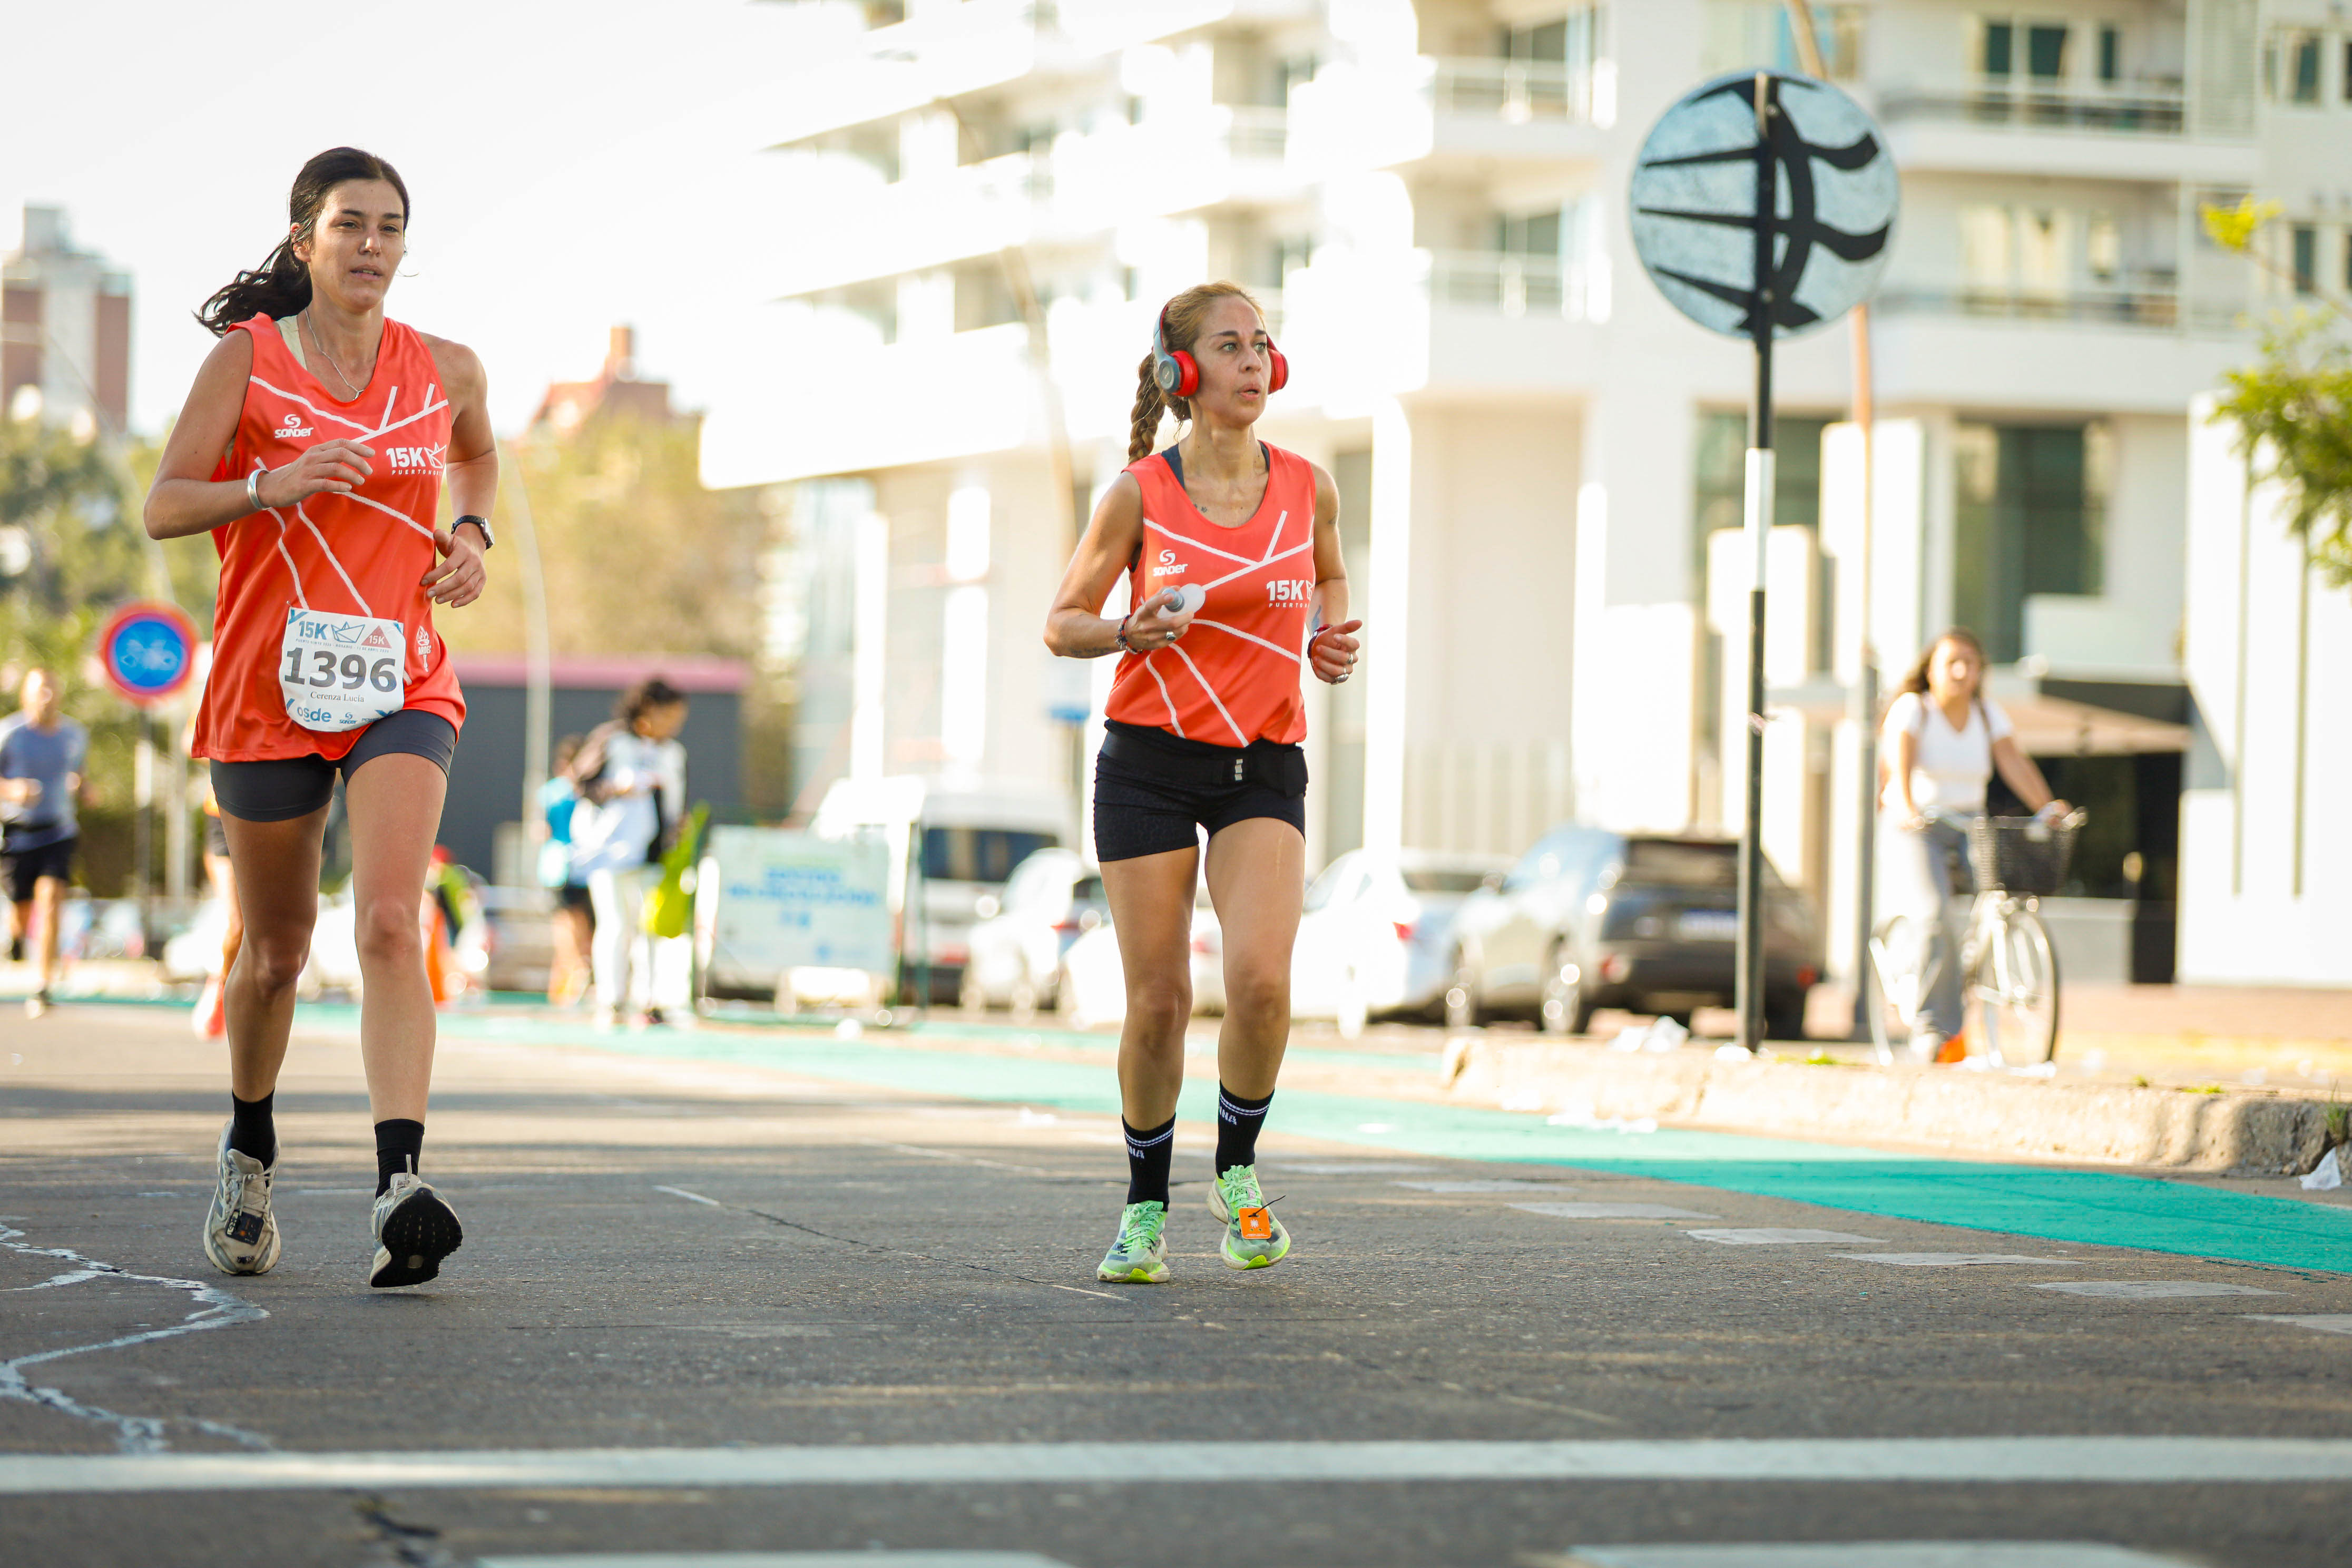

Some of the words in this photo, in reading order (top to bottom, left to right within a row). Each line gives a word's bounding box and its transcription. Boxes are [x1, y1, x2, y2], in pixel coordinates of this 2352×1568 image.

[386, 447, 426, 468] 15K
[1266, 580, 1305, 601] 15K
[299, 621, 328, 640] 15K
[369, 635, 385, 645] 15K
[285, 647, 397, 692] 1396
[310, 691, 341, 701] Cerenza
[297, 707, 331, 722] osde
